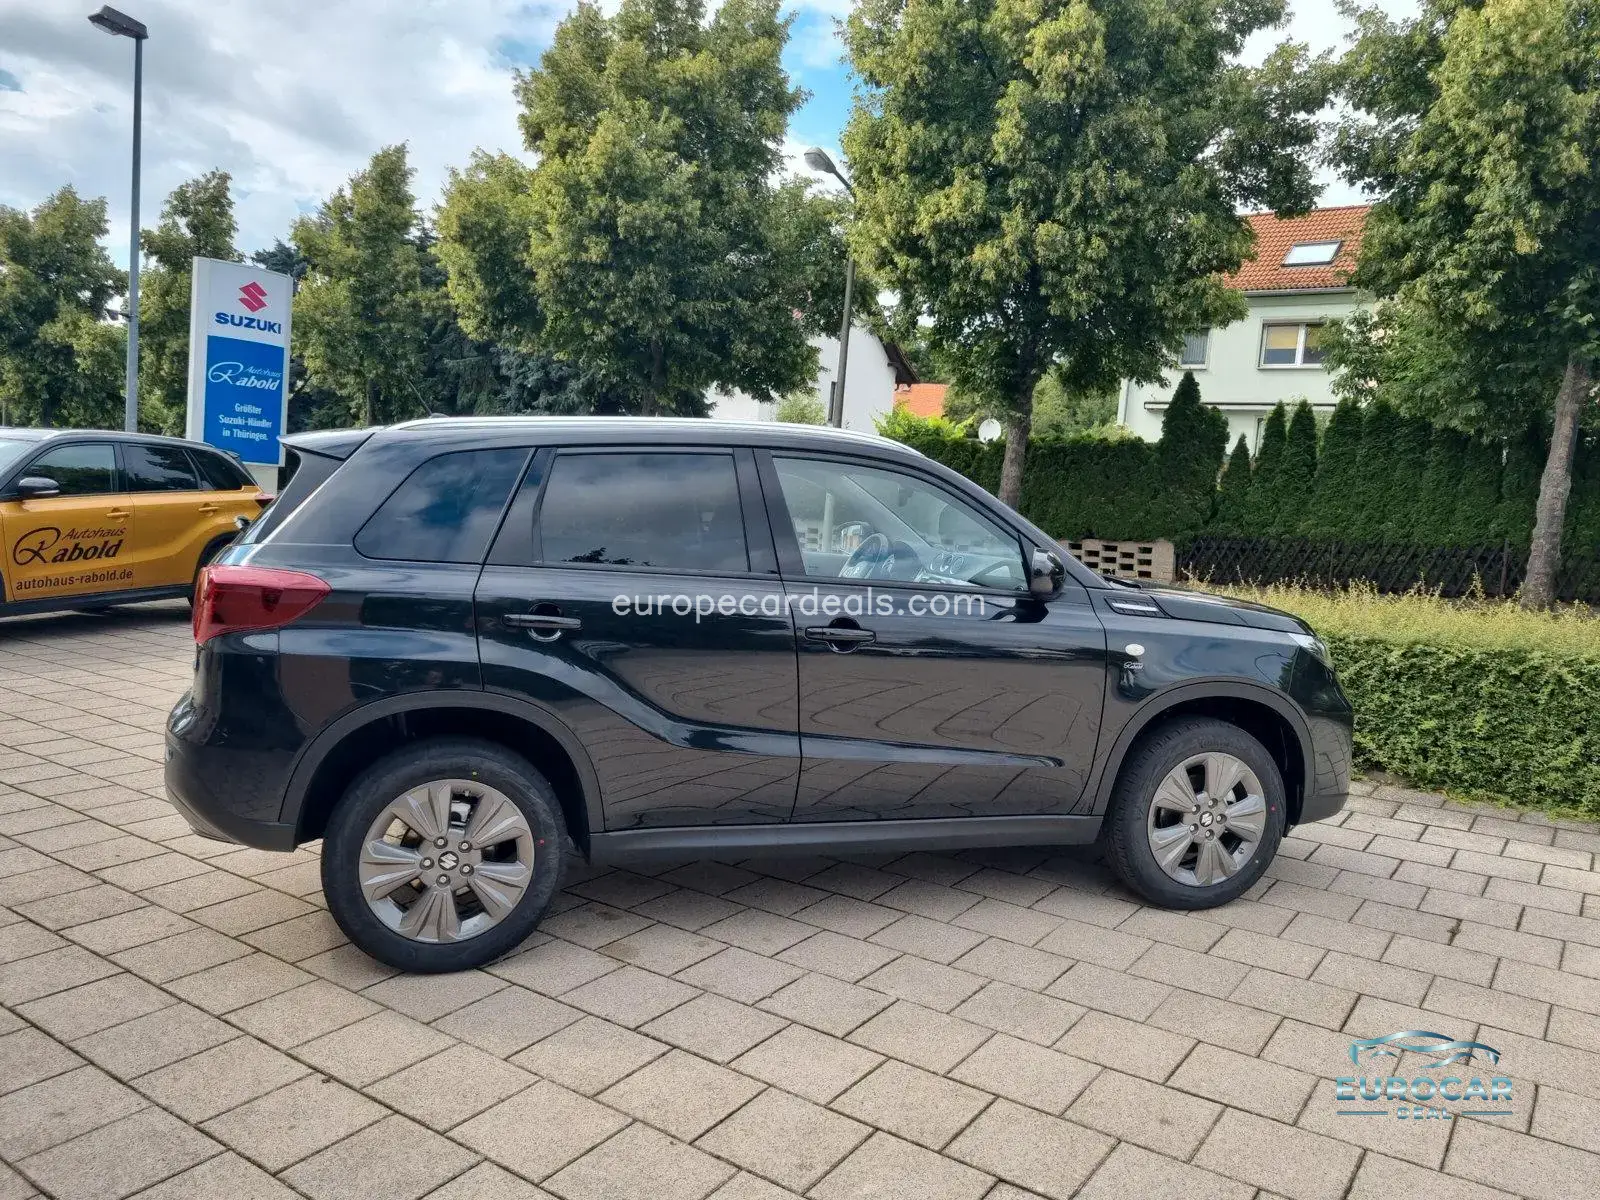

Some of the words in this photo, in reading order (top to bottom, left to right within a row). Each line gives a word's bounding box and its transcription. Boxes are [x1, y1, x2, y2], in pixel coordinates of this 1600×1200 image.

[214, 312, 282, 334] SUZUKI
[208, 361, 280, 391] Rabold
[244, 366, 281, 378] Autohaus
[234, 402, 262, 415] Größter
[218, 414, 272, 428] Suzuki-Händler
[222, 427, 231, 437] in
[61, 527, 127, 541] Autohaus
[13, 526, 124, 566] Rabold
[16, 569, 134, 591] autohaus-rabold.de
